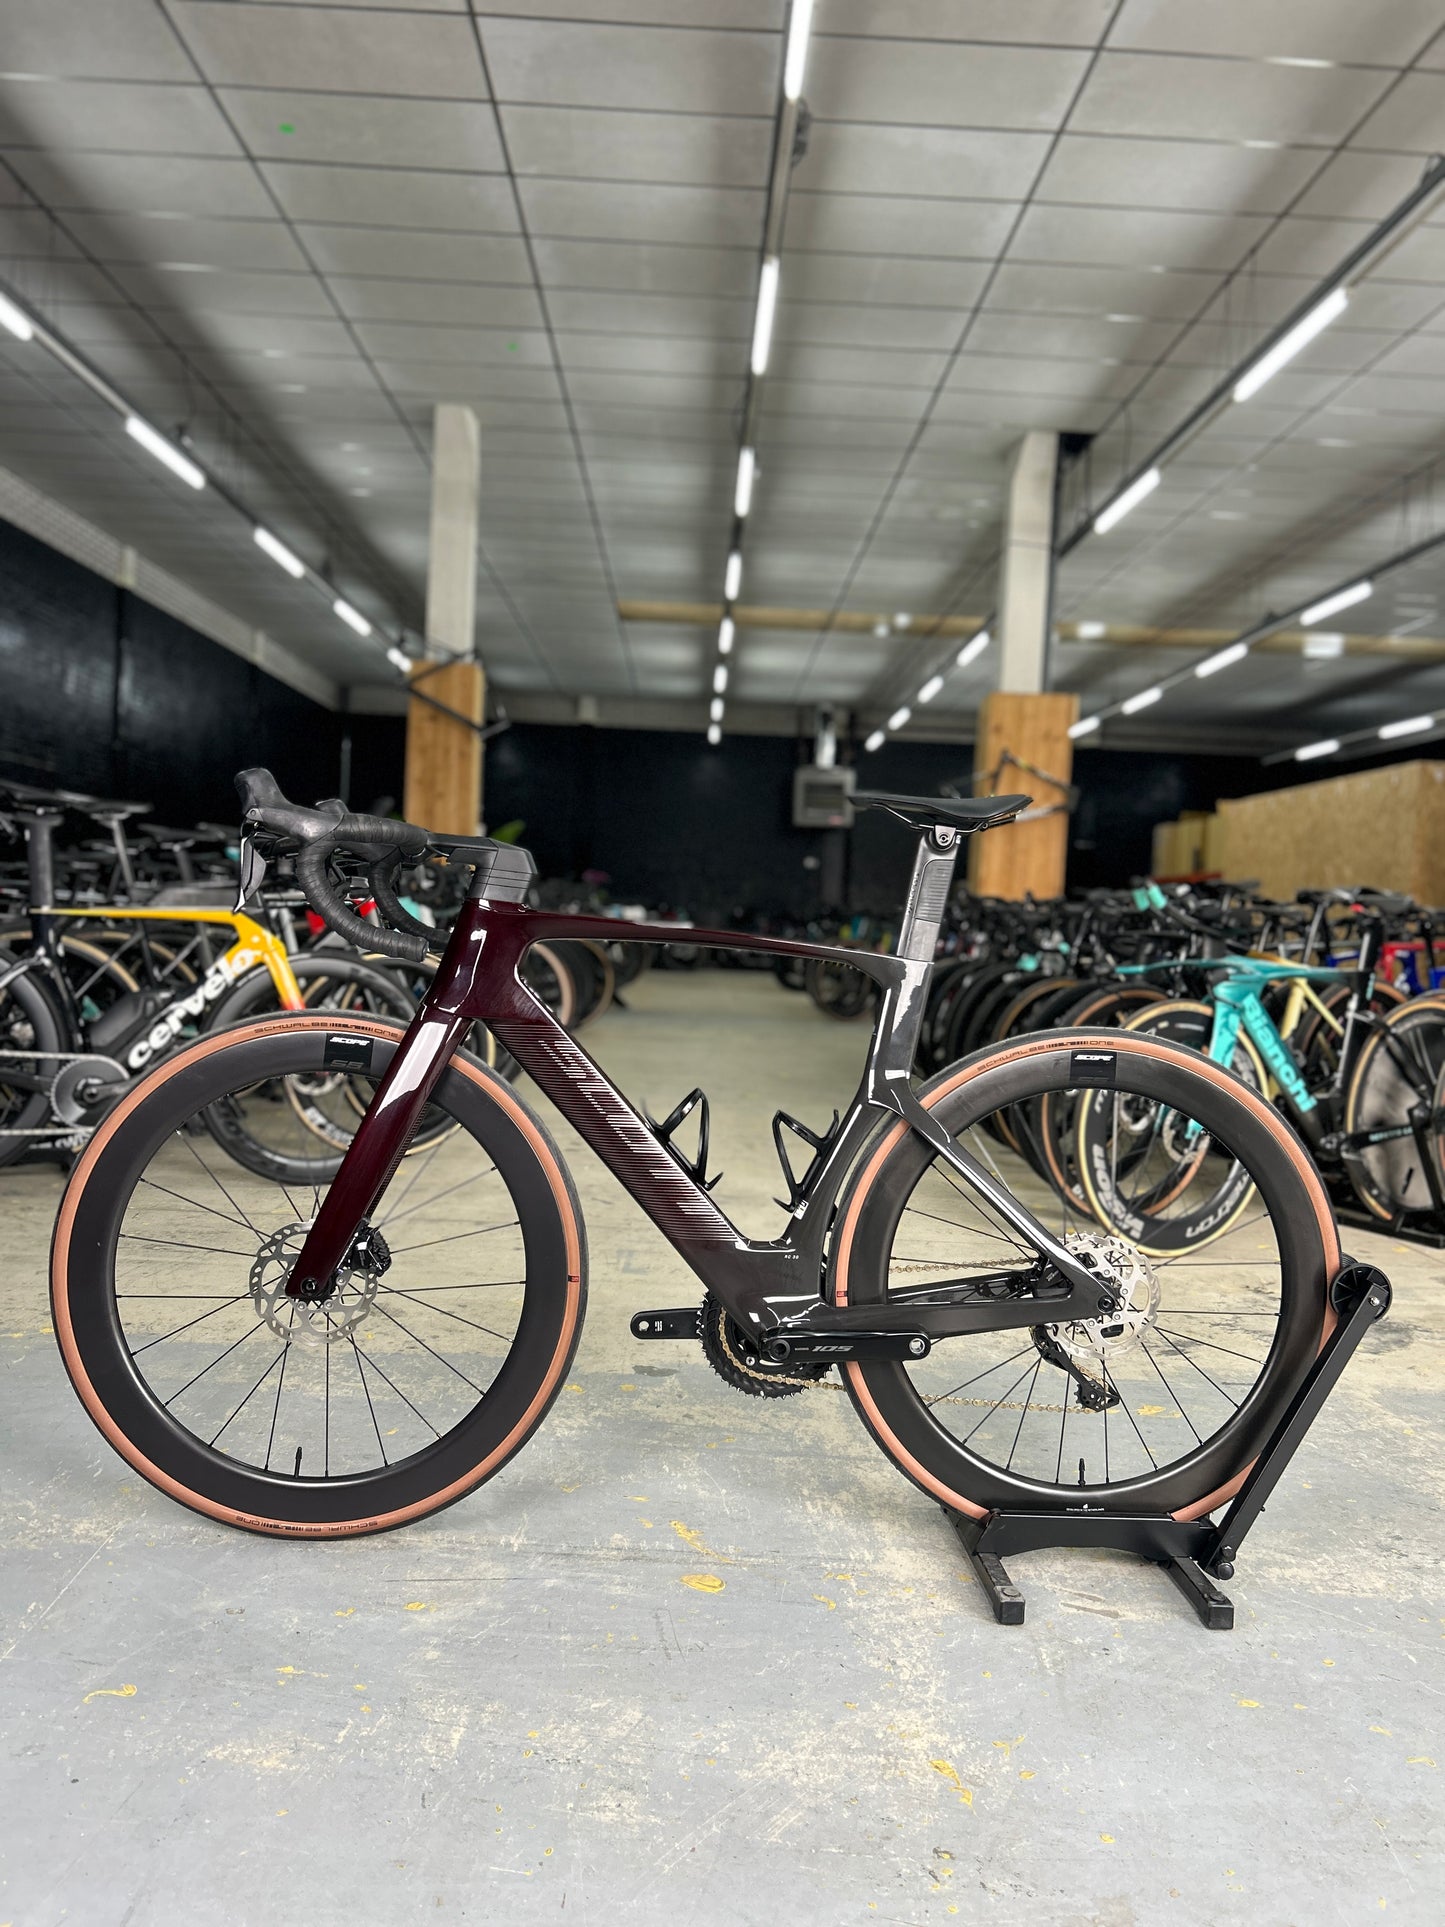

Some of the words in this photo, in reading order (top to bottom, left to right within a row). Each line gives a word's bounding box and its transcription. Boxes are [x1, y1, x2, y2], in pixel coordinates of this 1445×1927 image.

[254, 1022, 328, 1033] SCHWALBE
[374, 1028, 399, 1038] ONE
[330, 1037, 370, 1046] SCOPE
[977, 1045, 1045, 1072] SCHWALBE
[1074, 1054, 1114, 1062] SCOPE
[1242, 992, 1318, 1113] Bianchi
[235, 1515, 260, 1526] ONE
[304, 1520, 378, 1532] SCHWALBE
